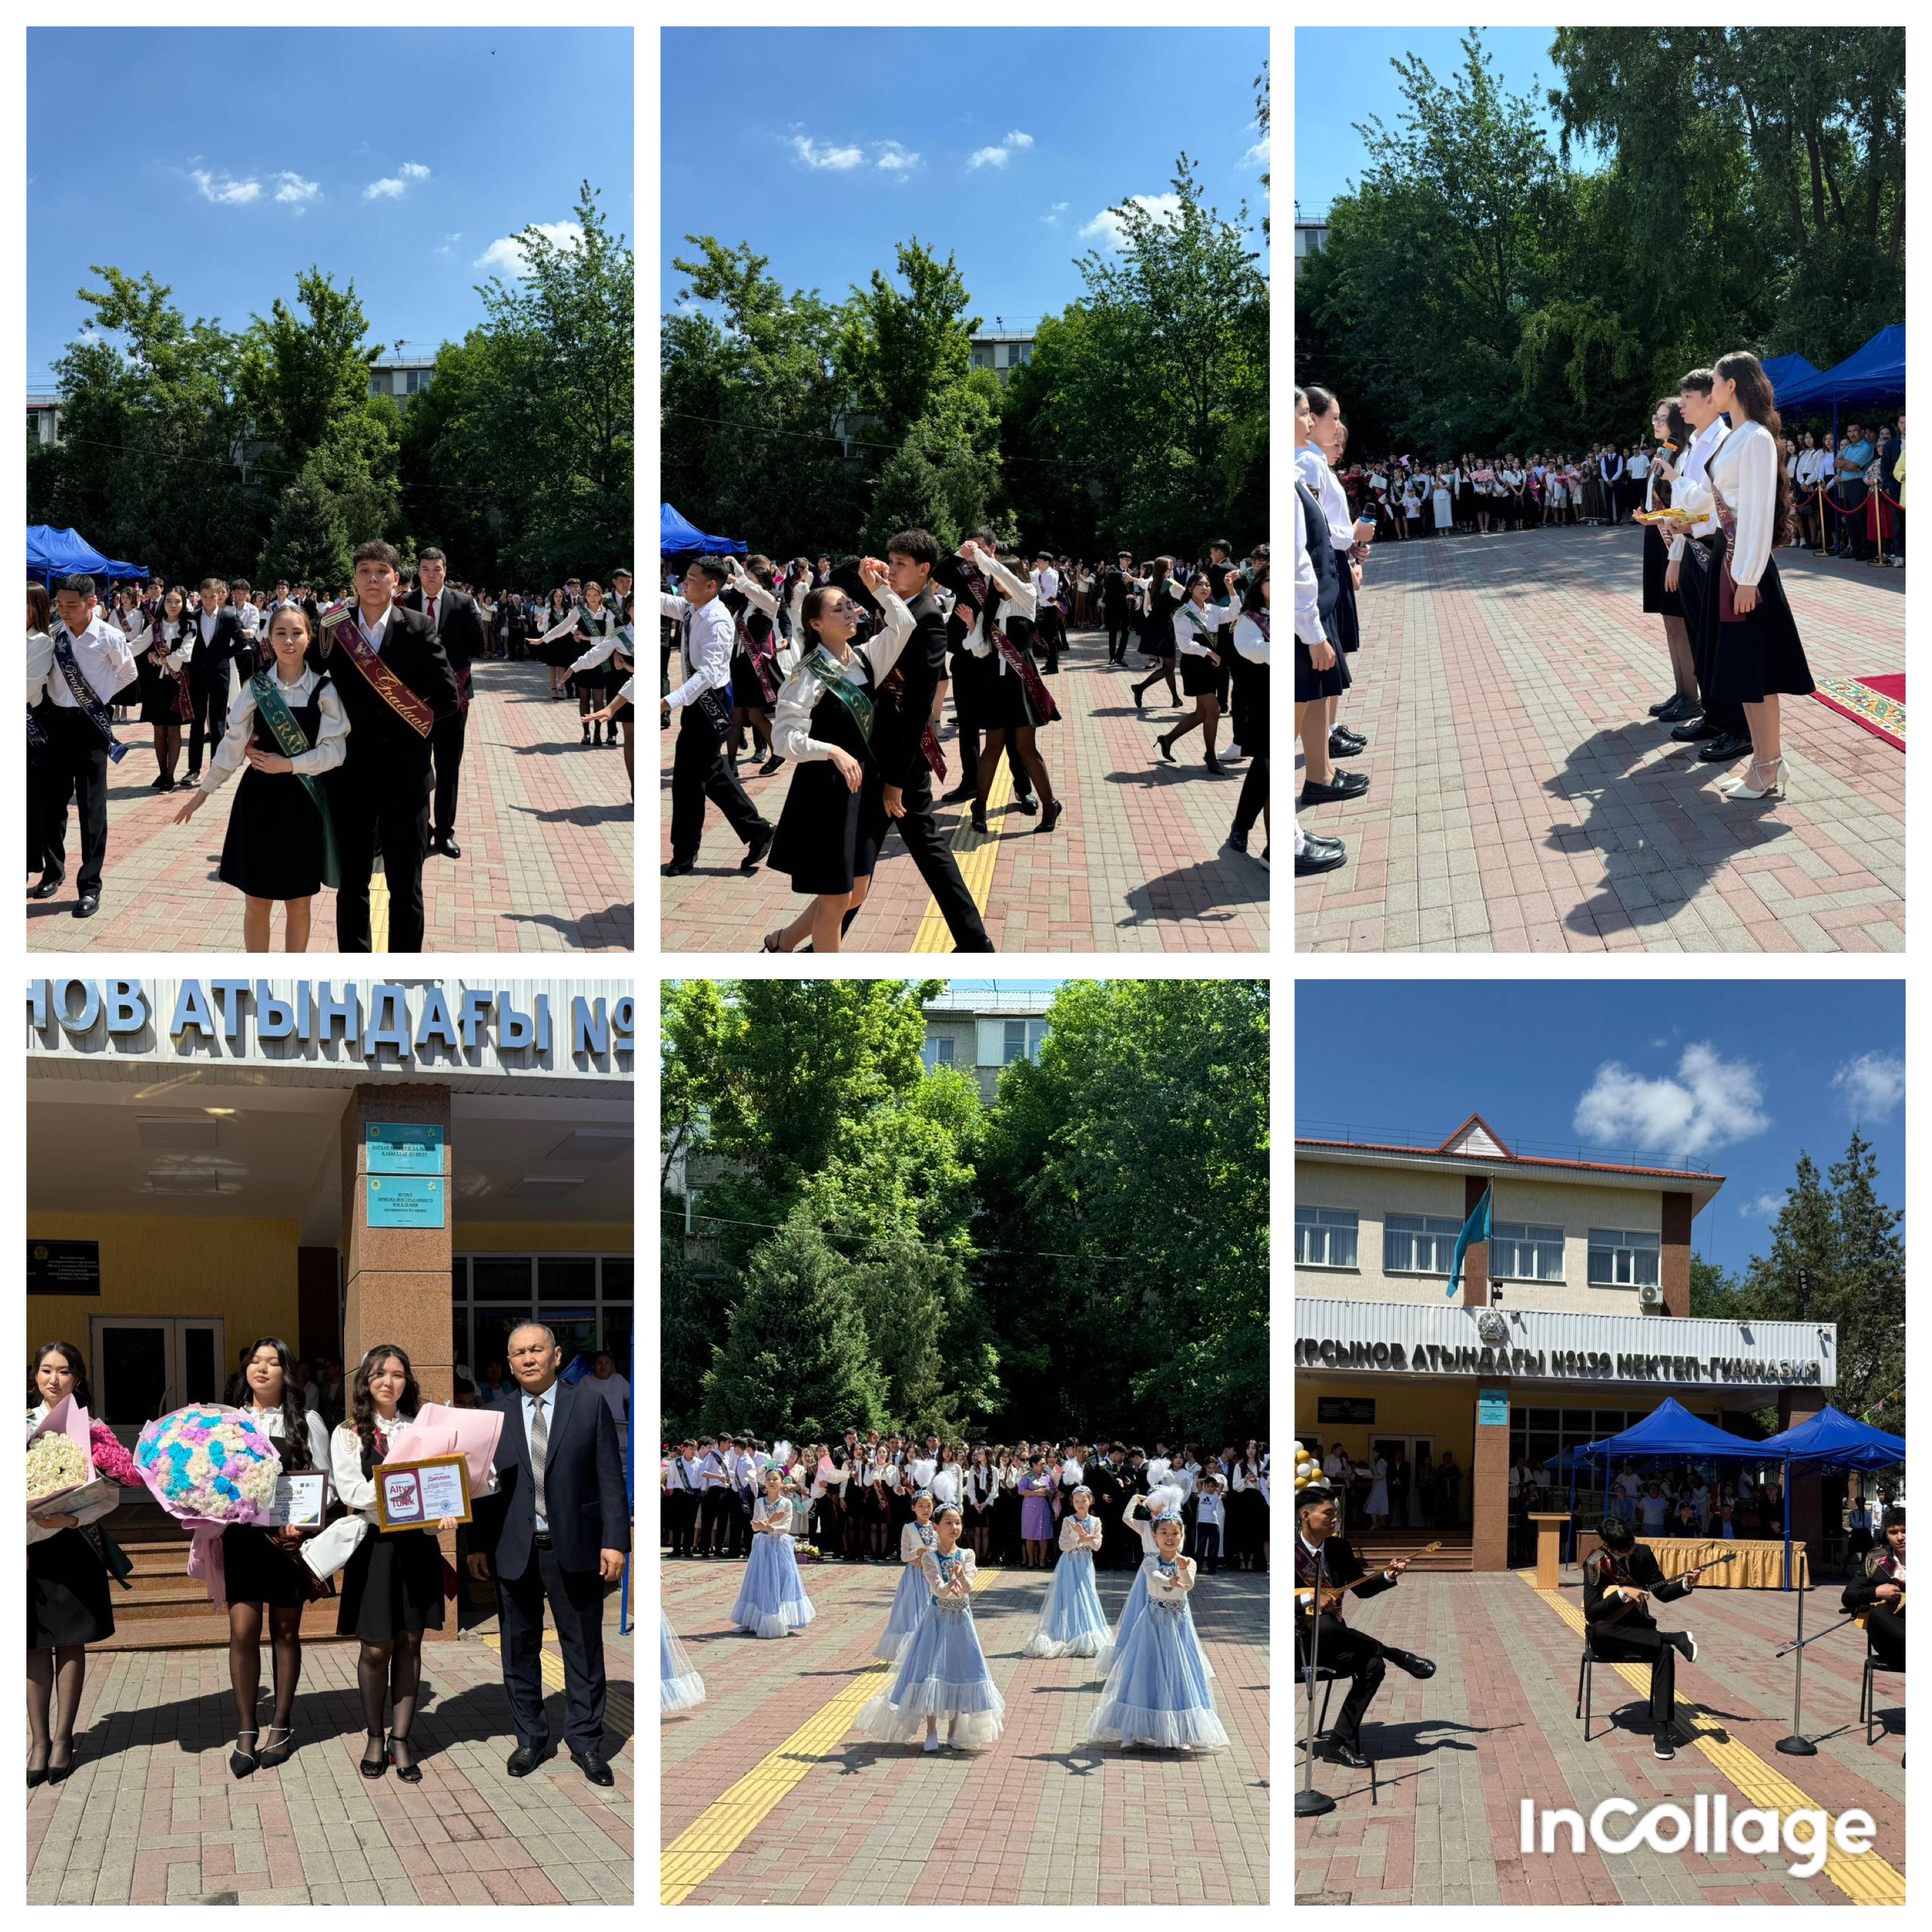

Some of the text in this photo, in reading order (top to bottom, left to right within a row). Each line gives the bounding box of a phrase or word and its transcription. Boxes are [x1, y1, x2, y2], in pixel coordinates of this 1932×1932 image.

[60, 659, 94, 709] Graduate
[94, 711, 111, 735] 202
[375, 668, 430, 733] Graduate
[170, 979, 550, 1060] АТЫНДАҒЫ
[1411, 1343, 1545, 1371] АТЫНДАҒЫ
[1551, 1350, 1611, 1372] №139
[1616, 1353, 1820, 1380] МЕКТЕП-ГИМНАЗИЯ
